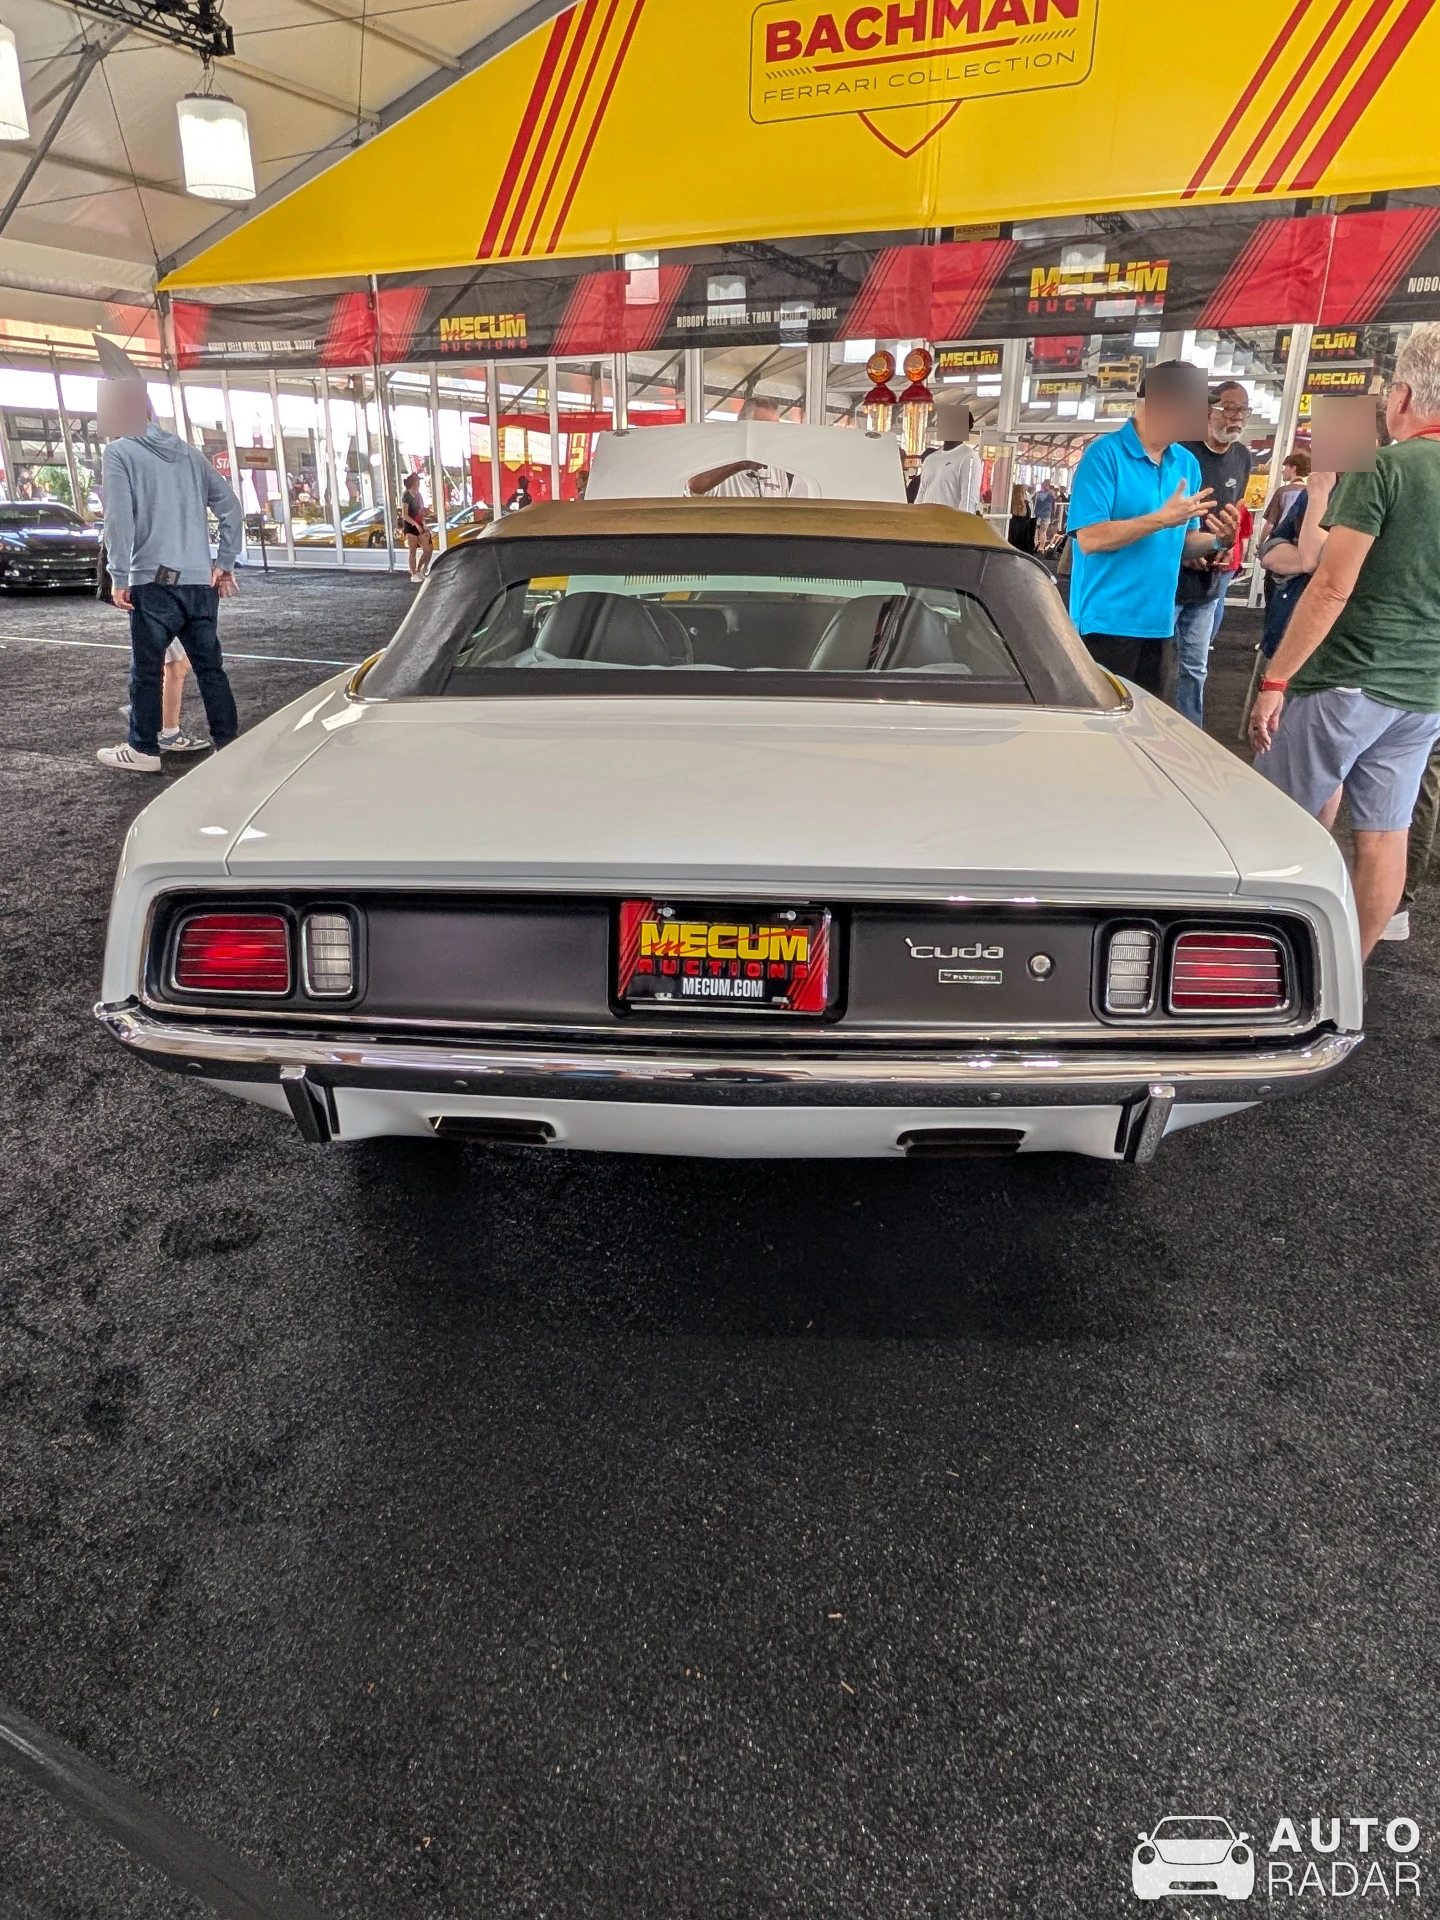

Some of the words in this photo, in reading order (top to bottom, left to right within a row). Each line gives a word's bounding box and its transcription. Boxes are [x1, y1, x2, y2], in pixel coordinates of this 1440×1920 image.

[763, 77, 878, 104] FERRARI
[888, 49, 1076, 87] COLLECTION
[1030, 260, 1169, 298] MECUM
[1407, 276, 1440, 293] NOBO
[440, 313, 527, 341] MECUM
[677, 316, 704, 328] NOBODY
[752, 311, 772, 324] THAN
[440, 339, 528, 352] AUCTIONS
[1281, 332, 1358, 351] MCUM
[940, 350, 998, 367] MECUM
[1308, 372, 1366, 386] MECUM
[640, 922, 809, 962] MECUM
[638, 958, 809, 979] AUCTIONS
[682, 977, 764, 998] MECUM.COM
